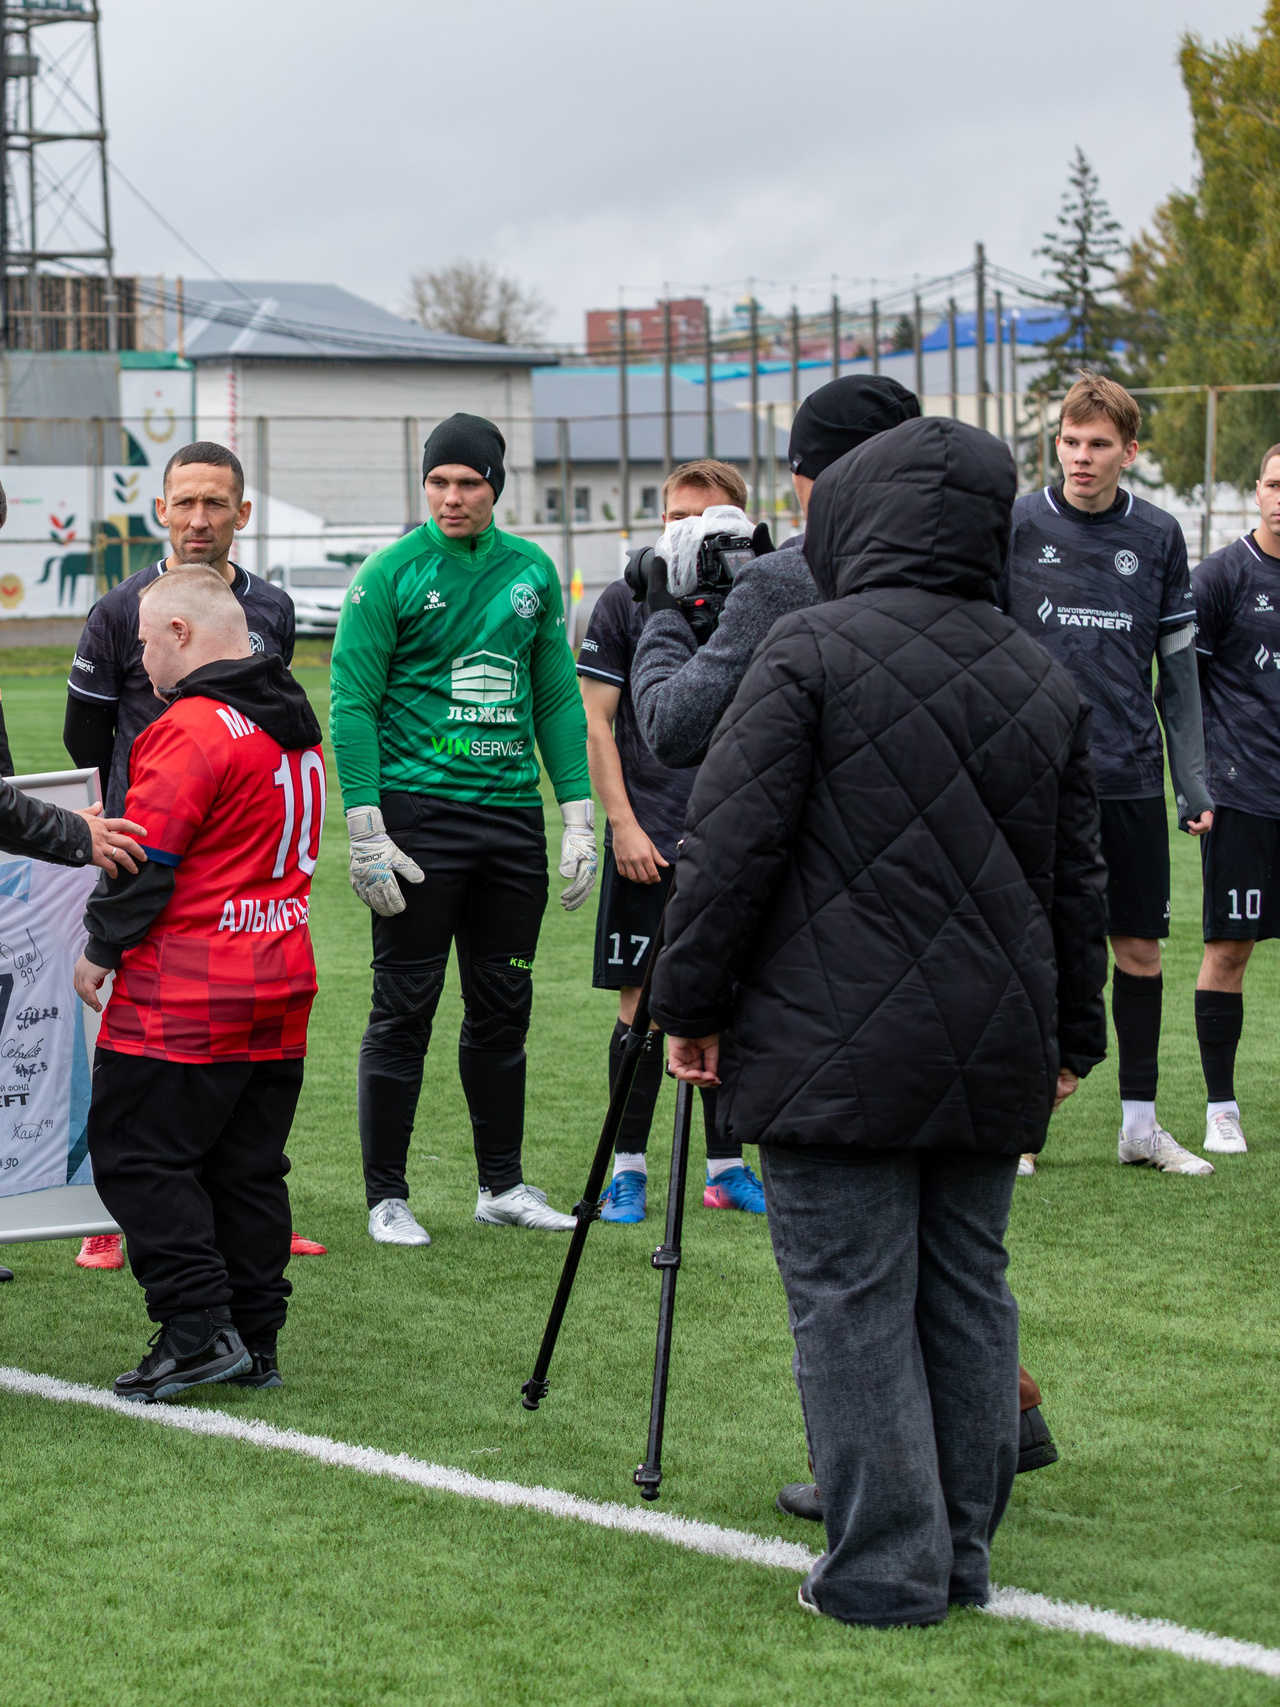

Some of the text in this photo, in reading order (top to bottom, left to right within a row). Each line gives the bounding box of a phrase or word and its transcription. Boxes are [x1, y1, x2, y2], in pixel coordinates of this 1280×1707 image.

[424, 602, 447, 611] KELME
[1057, 606, 1119, 618] БЛАГОТВОРИТЕЛЬНЫЙ
[1056, 613, 1133, 632] TATNEFT
[446, 706, 518, 724] ЛЗЖБК
[273, 748, 327, 880] 10
[1228, 888, 1261, 920] 10
[608, 932, 650, 967] 17
[21, 967, 36, 988] 99
[7, 1083, 30, 1093] ФОНД
